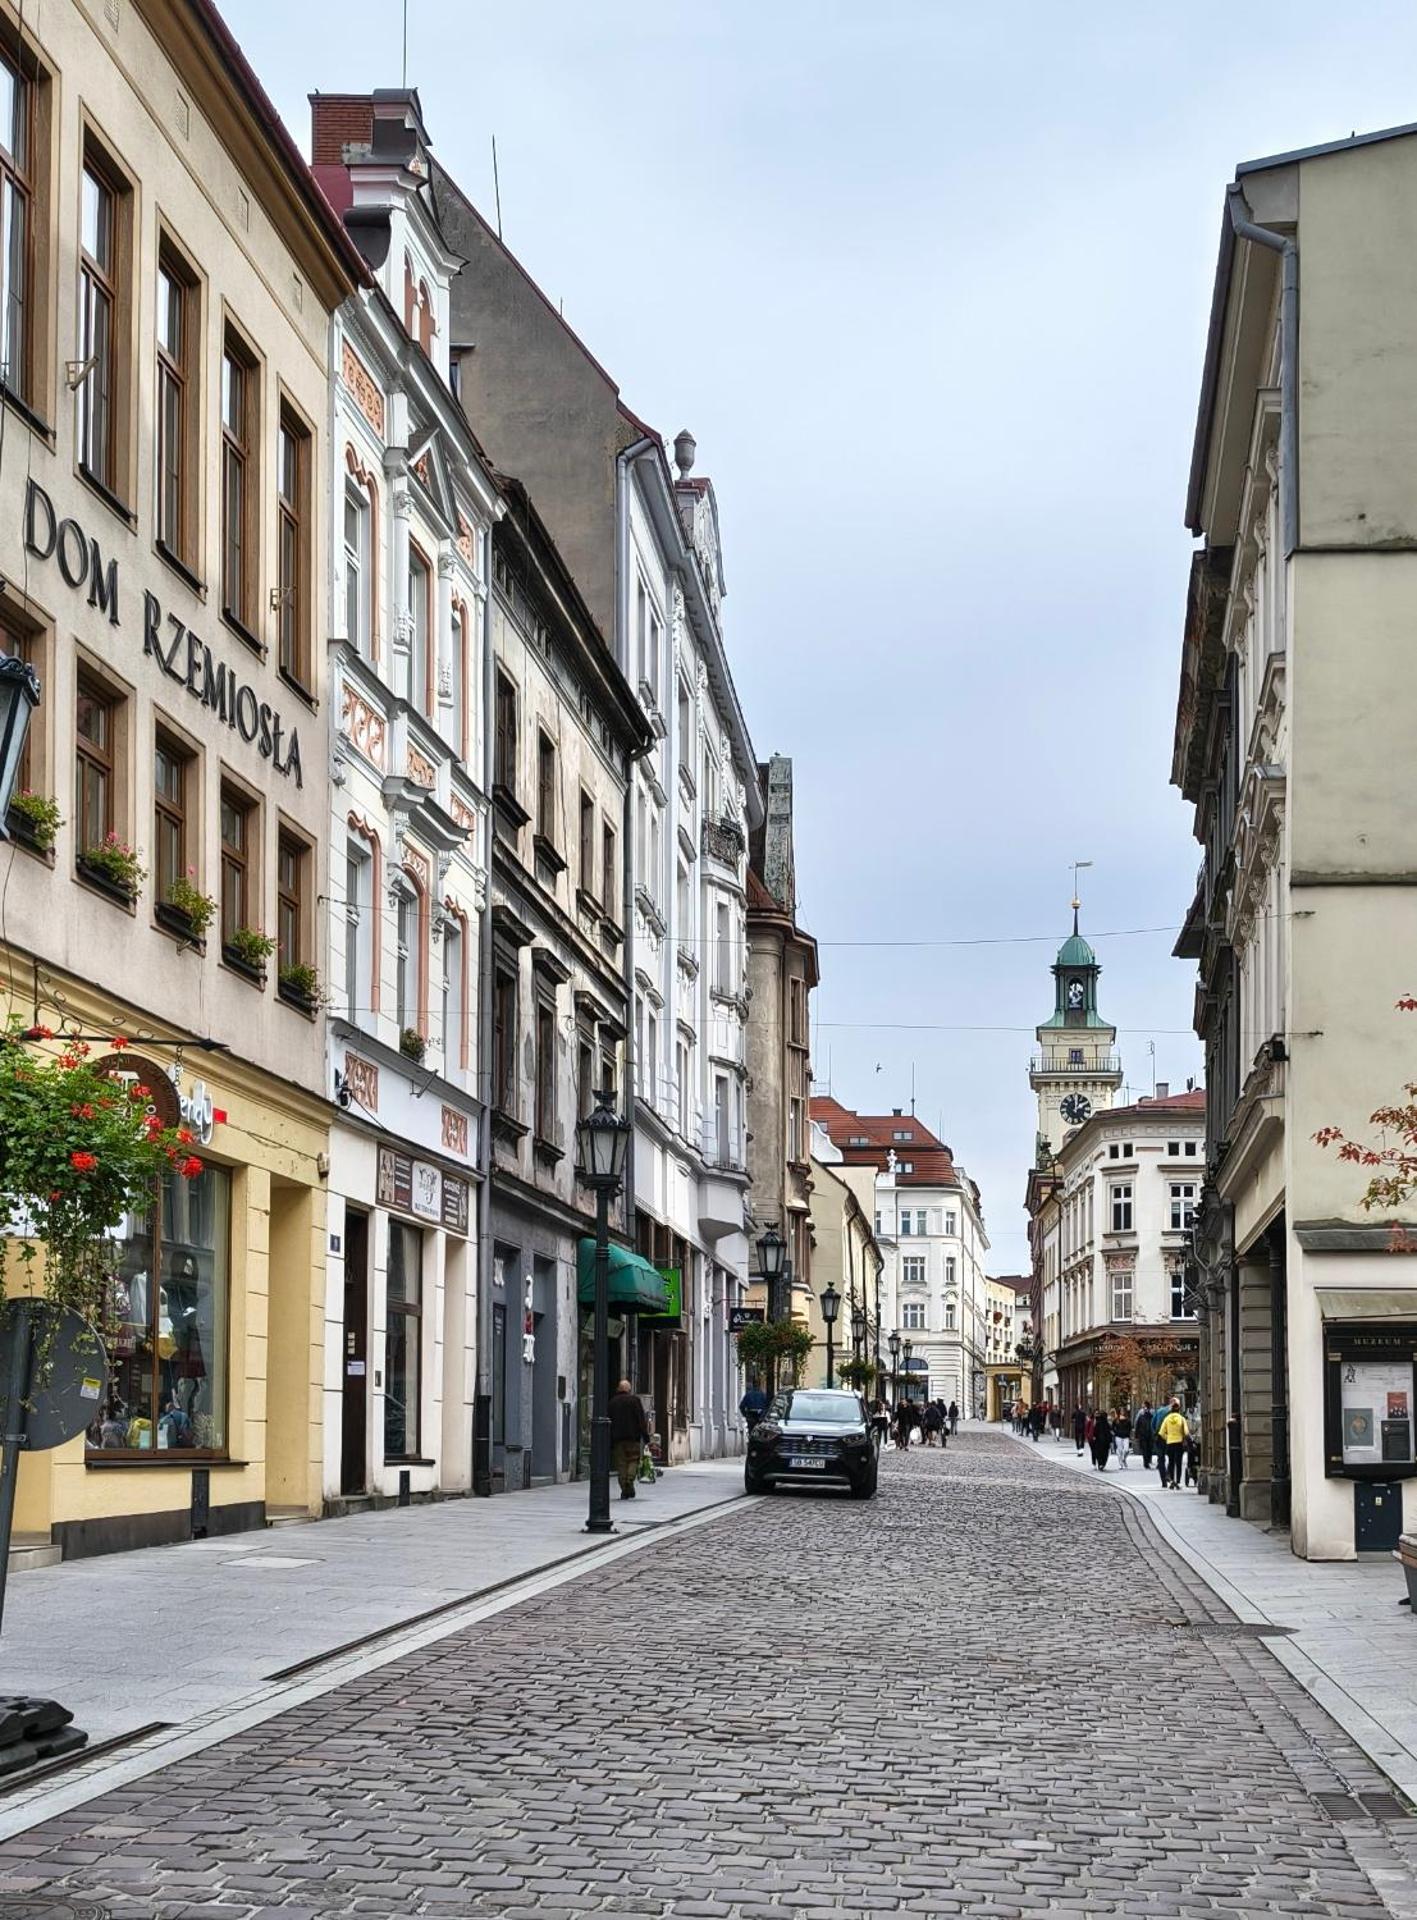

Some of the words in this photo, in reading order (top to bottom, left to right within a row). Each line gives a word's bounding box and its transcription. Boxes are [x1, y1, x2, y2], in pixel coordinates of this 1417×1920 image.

[25, 477, 120, 626] DOM
[143, 588, 303, 789] RZEMIOSŁA
[1353, 1338, 1401, 1346] MUZEUM
